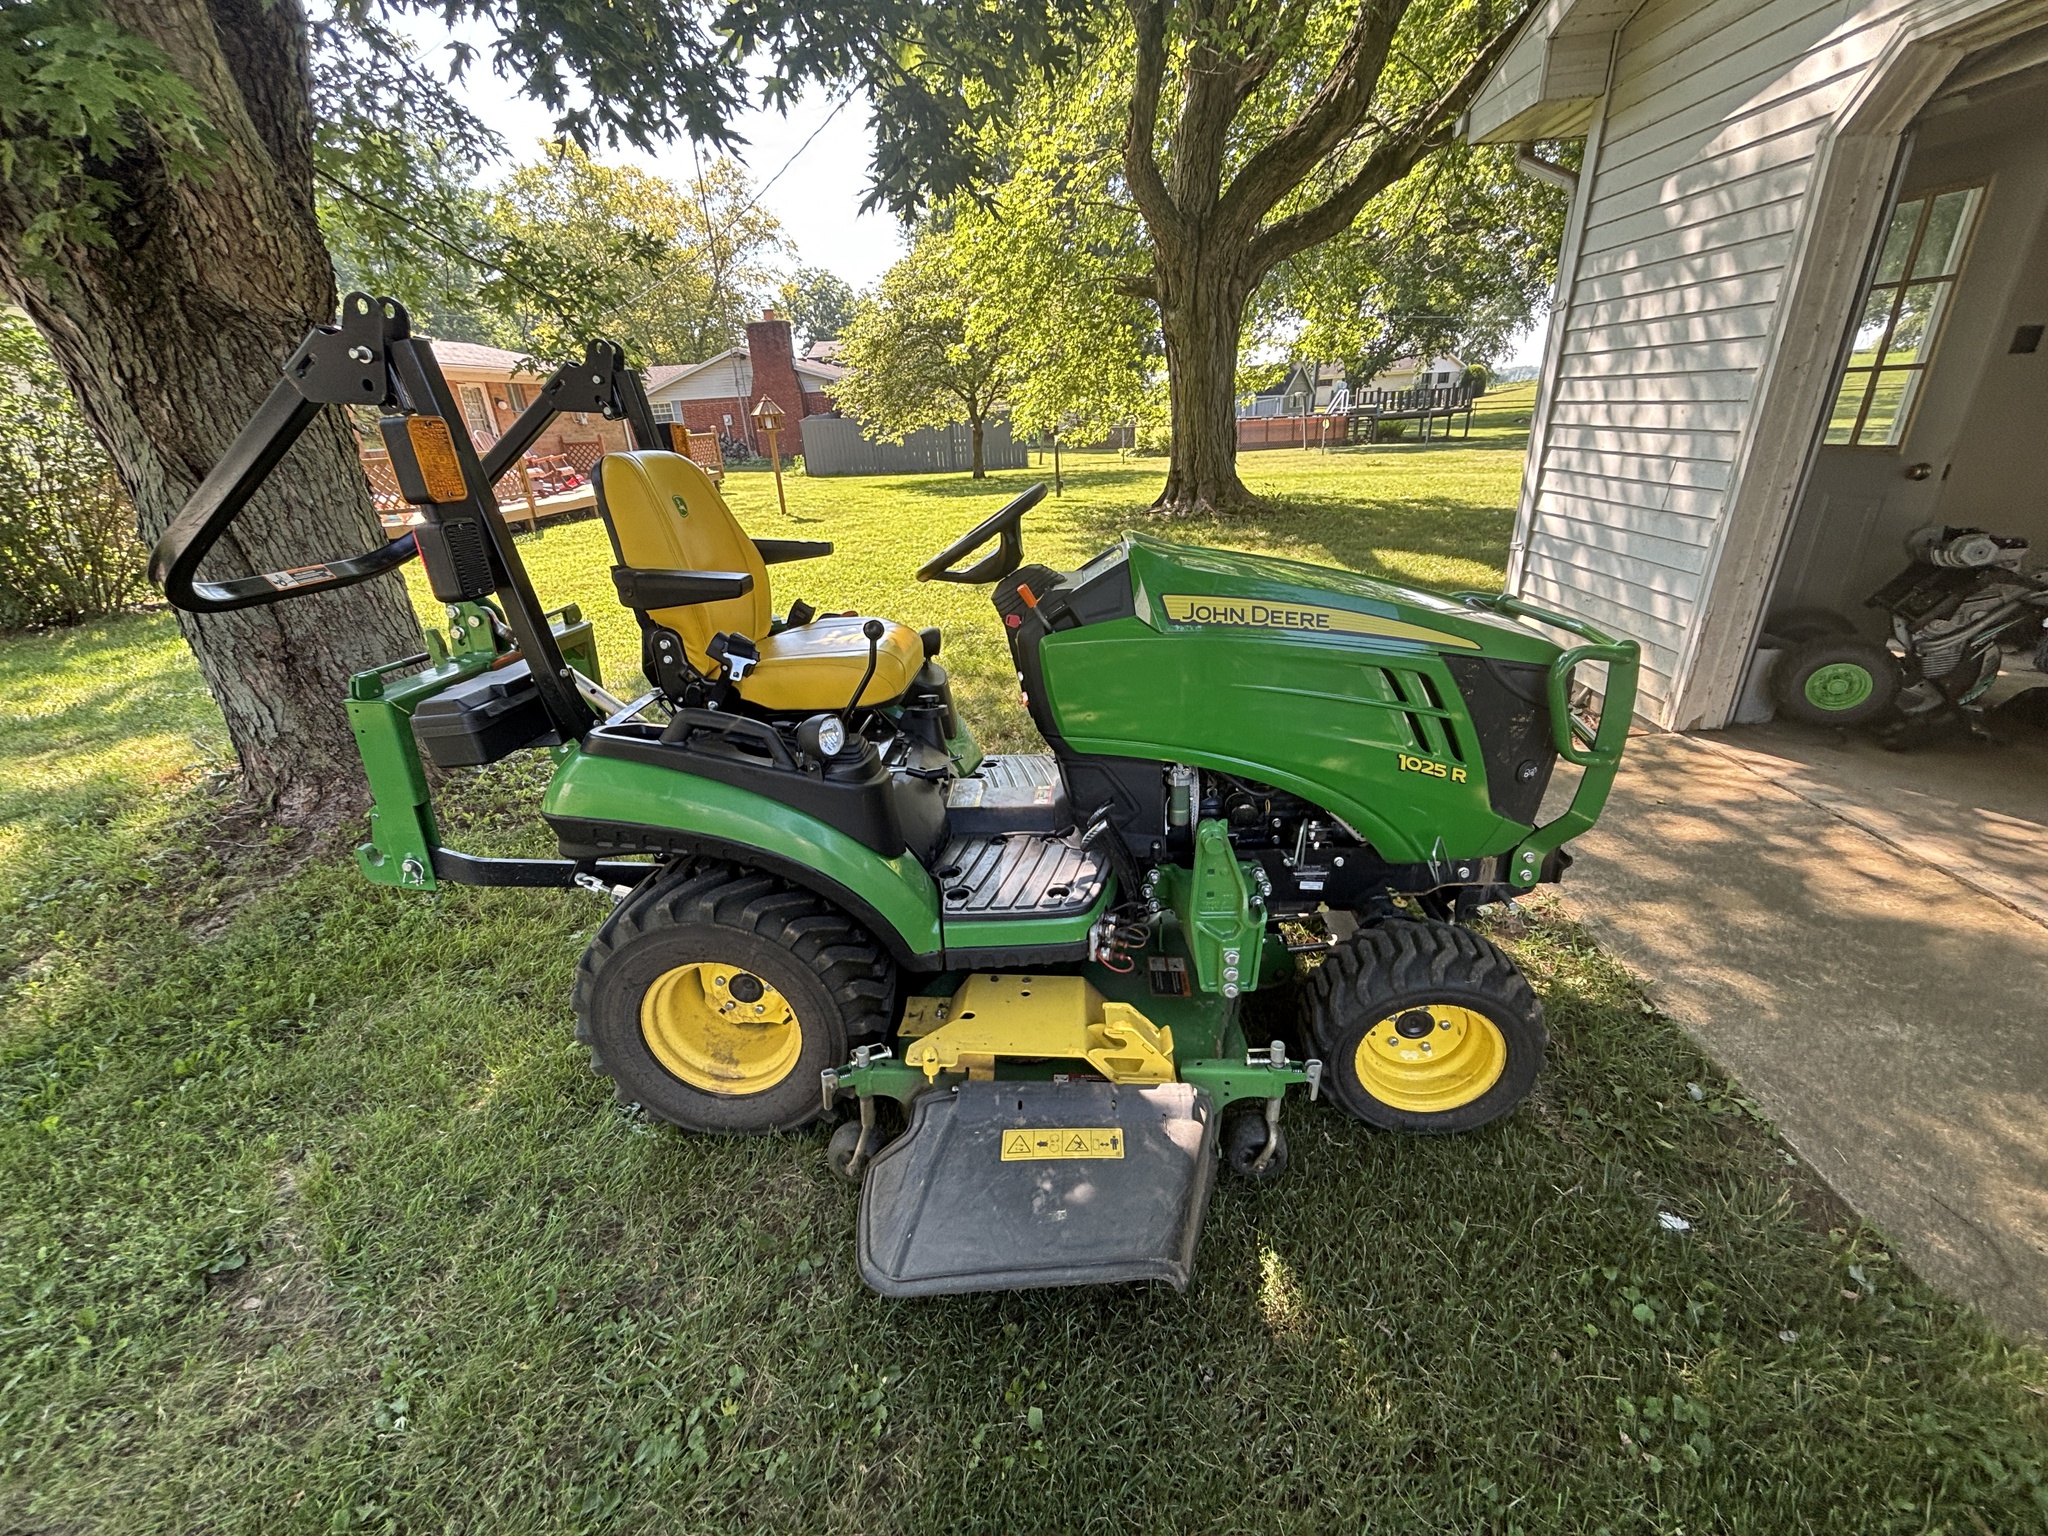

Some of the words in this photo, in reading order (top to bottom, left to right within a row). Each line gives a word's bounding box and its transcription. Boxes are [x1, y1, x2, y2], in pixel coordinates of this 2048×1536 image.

[1182, 602, 1245, 623] JOHN
[1251, 605, 1330, 628] DEERE
[1398, 753, 1447, 778] 1025
[1451, 767, 1467, 784] R
